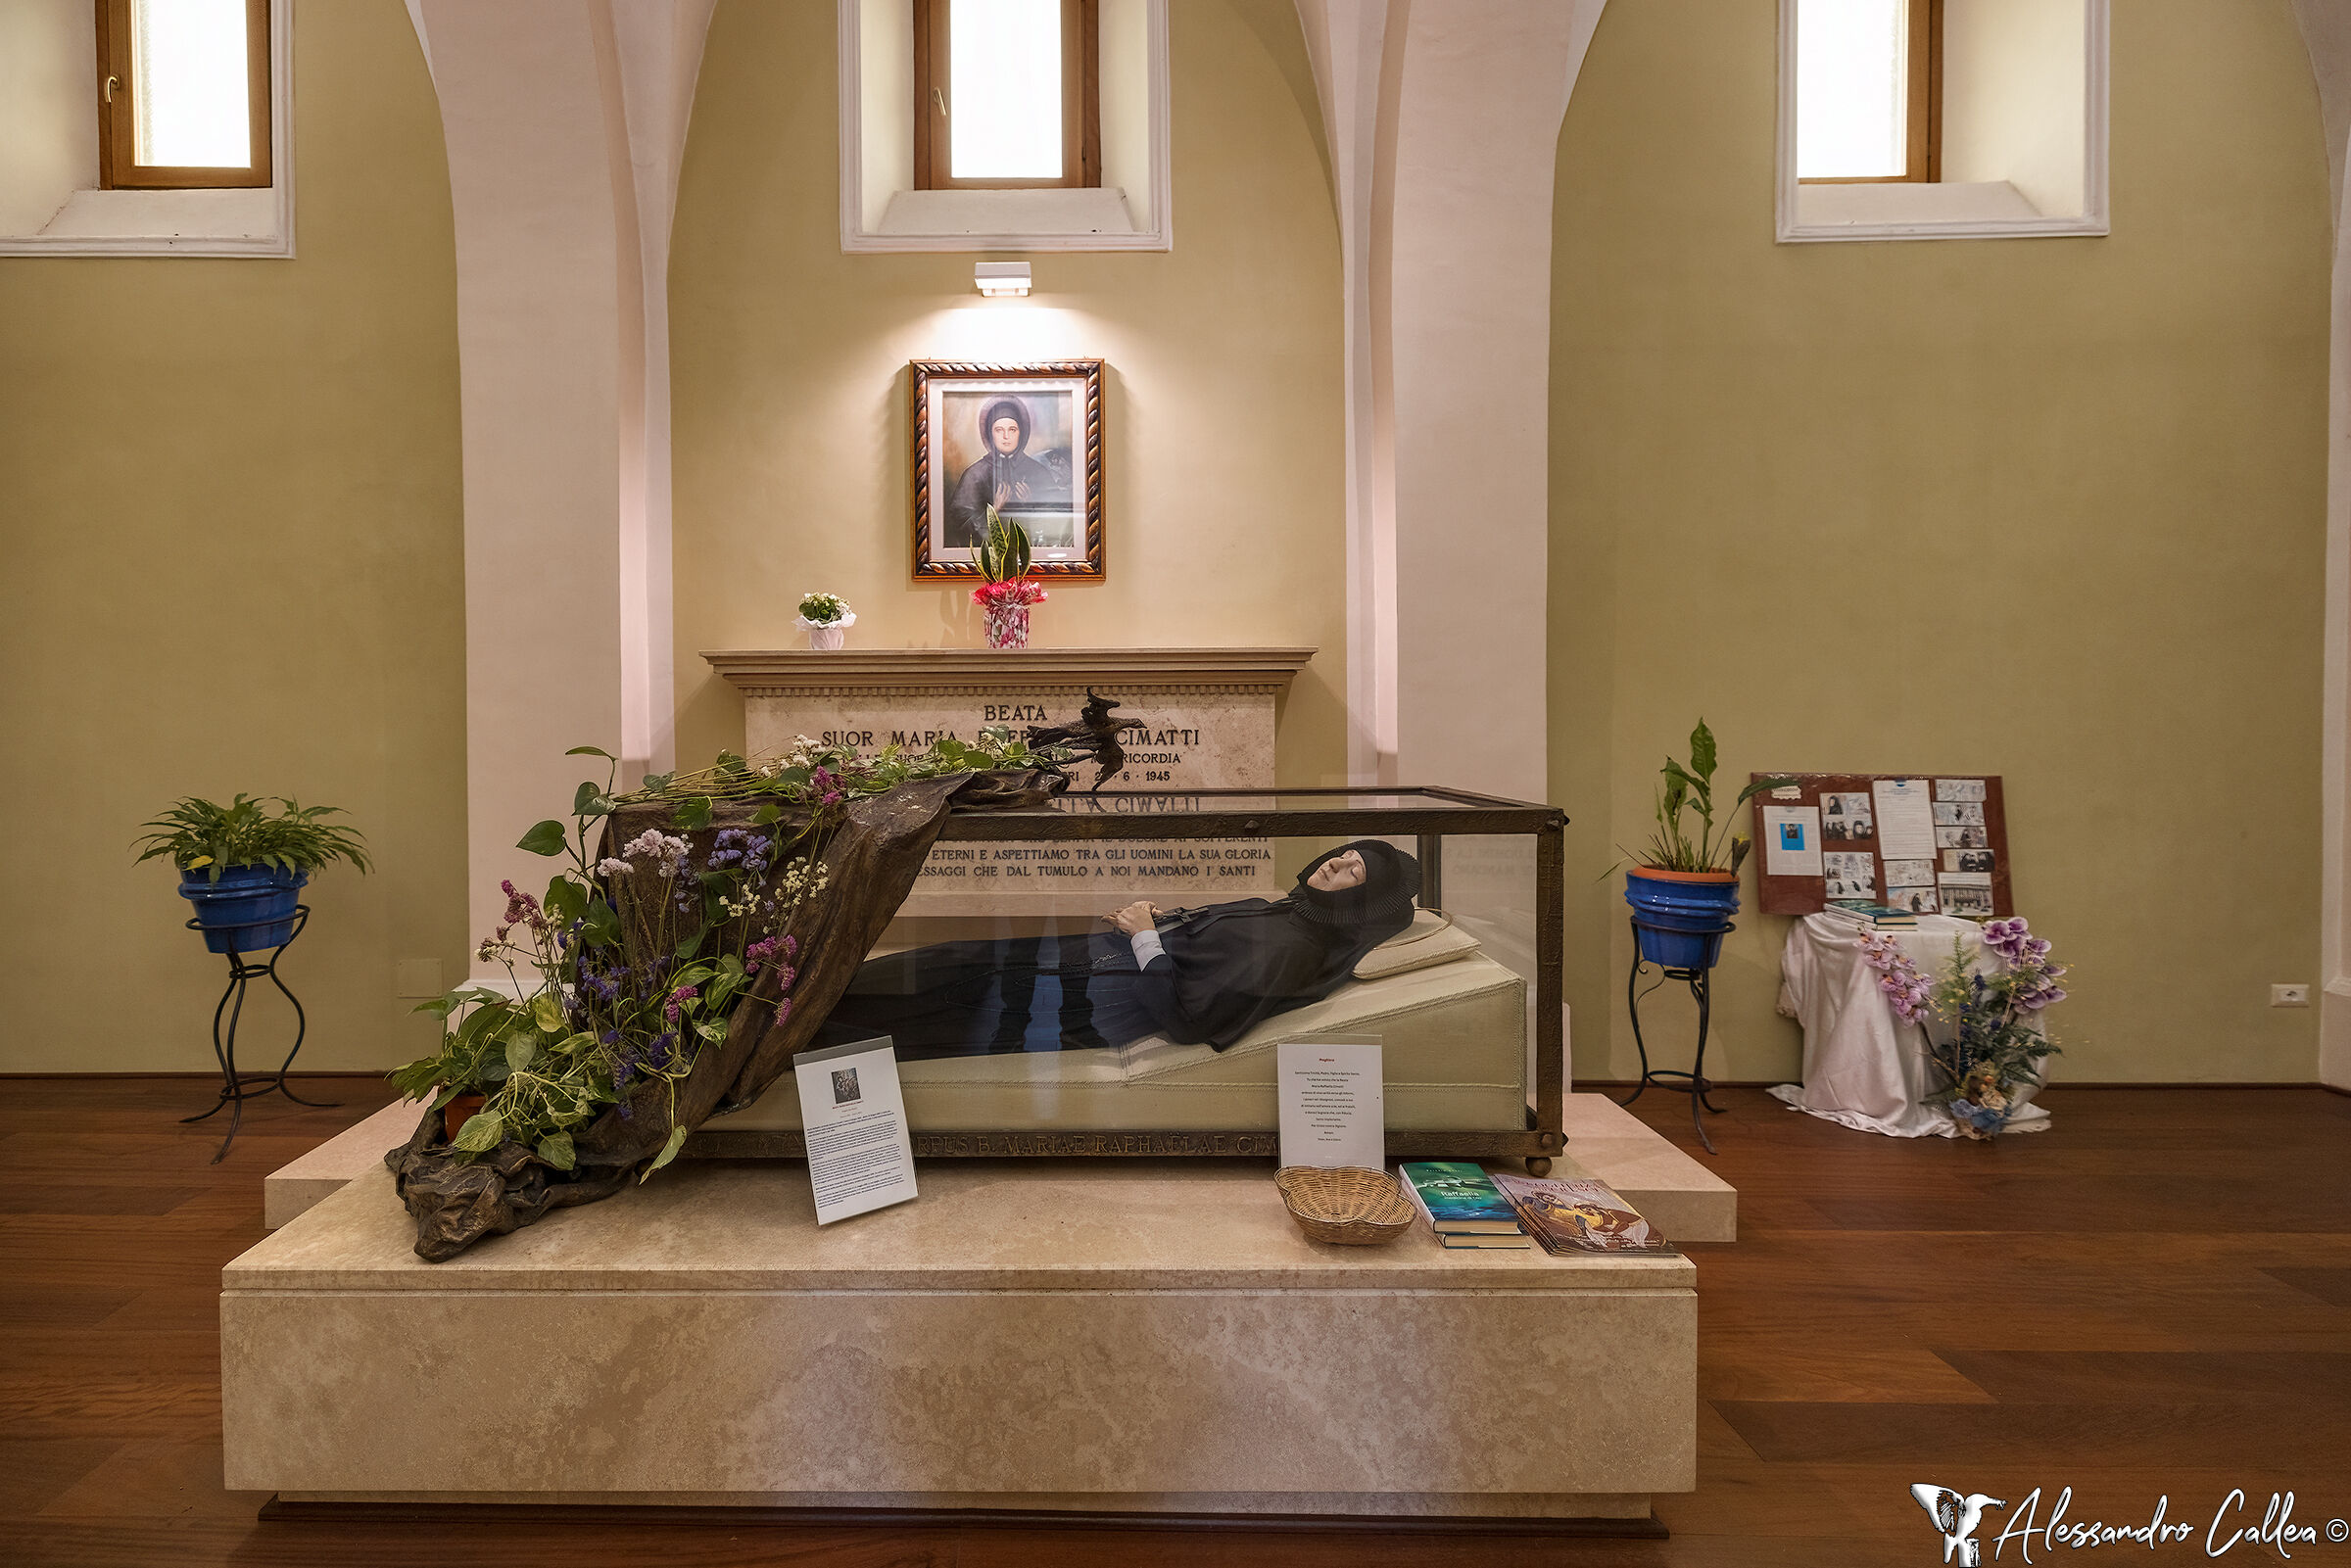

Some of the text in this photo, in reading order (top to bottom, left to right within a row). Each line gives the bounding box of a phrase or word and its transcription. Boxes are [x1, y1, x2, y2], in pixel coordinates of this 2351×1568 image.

[984, 704, 1048, 722] BEATA
[821, 730, 874, 747] SUOR
[1115, 729, 1200, 746] CIMATTI
[1090, 752, 1181, 764] RICORDIA
[1123, 771, 1130, 782] 6
[1145, 771, 1171, 782] 1945
[932, 849, 1271, 861] ETERNI E ASPETTIAMO TRA GLI UOMINI LA SUA GLORIA
[973, 866, 998, 878] CHE
[1006, 866, 1032, 878] DAL
[1037, 866, 1088, 878] TUMULO
[1095, 866, 1105, 878] A
[1110, 866, 1131, 878] NOI
[1137, 866, 1200, 878] MANDANO
[1219, 866, 1256, 878] SANTI
[916, 1136, 970, 1154] RPUS
[976, 1136, 995, 1153] B.
[1003, 1136, 1085, 1154] MARIAE
